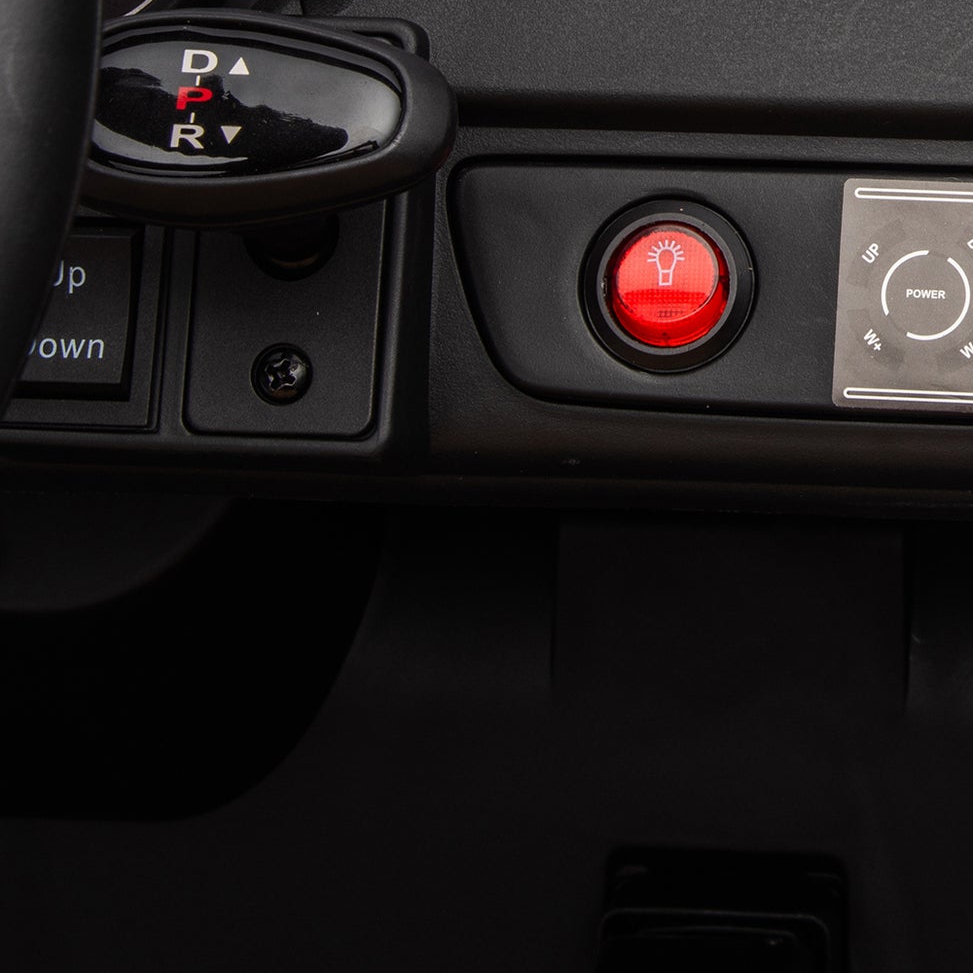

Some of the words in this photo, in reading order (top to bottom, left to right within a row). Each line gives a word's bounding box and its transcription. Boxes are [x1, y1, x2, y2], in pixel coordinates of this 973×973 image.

[181, 49, 218, 74] D
[175, 86, 213, 111] P
[170, 124, 205, 149] R
[861, 242, 881, 264] UP
[906, 288, 946, 300] POWER
[28, 336, 105, 359] own
[863, 328, 882, 353] W+
